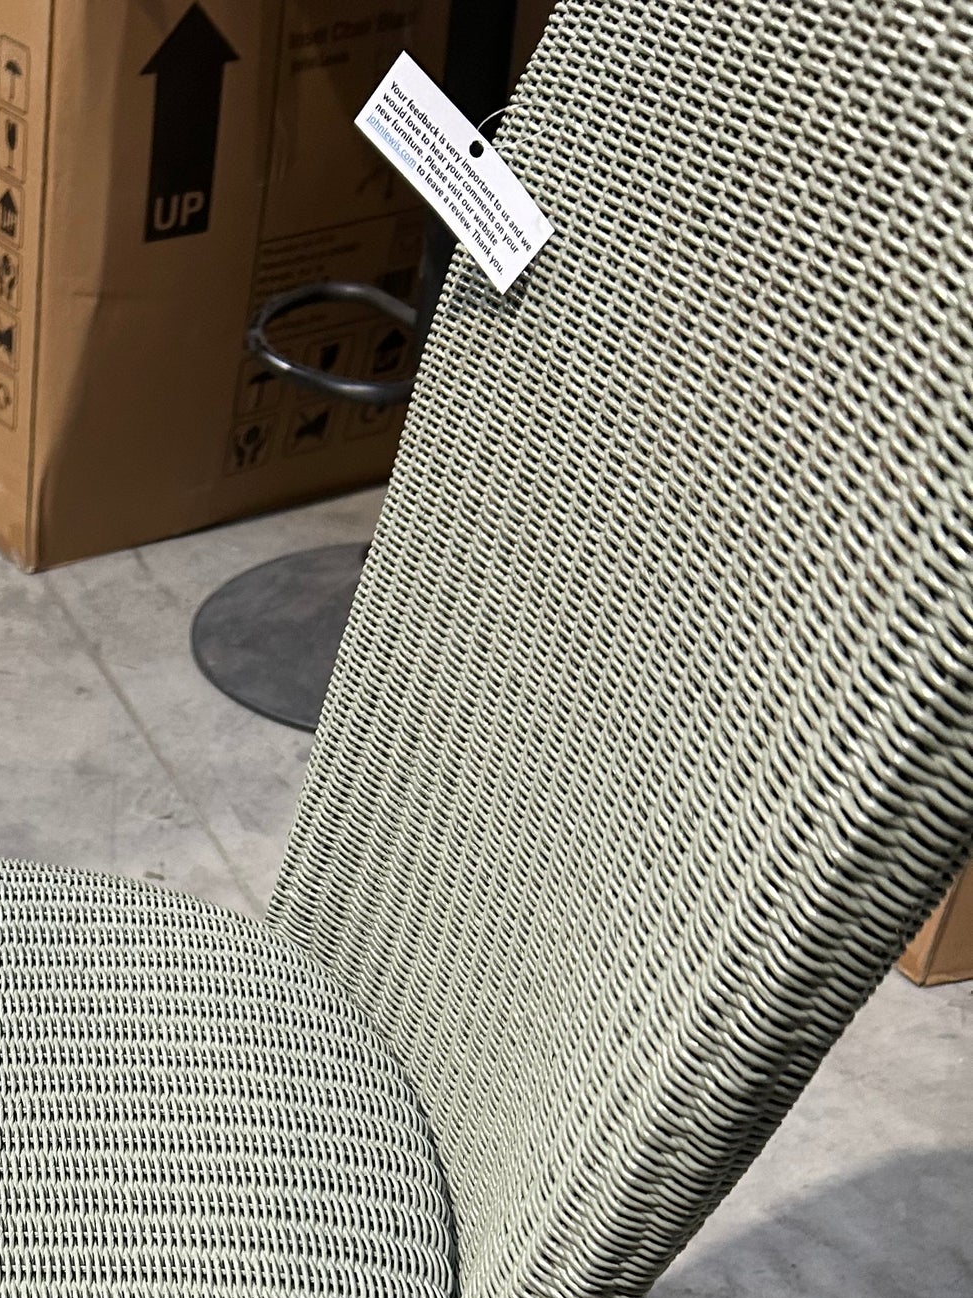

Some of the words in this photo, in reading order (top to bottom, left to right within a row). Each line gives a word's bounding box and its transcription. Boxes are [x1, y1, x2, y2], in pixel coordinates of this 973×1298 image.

[154, 191, 205, 231] UP
[366, 113, 417, 169] johnlewis.com
[416, 164, 425, 176] to
[425, 173, 444, 197] leave
[443, 196, 449, 204] a
[448, 202, 472, 231] review.
[472, 229, 491, 257] Thank
[489, 256, 504, 275] you.
[375, 104, 392, 122] new
[391, 119, 423, 158] furniture.
[424, 155, 448, 183] Please
[447, 181, 463, 200] visit
[461, 199, 474, 214] our
[473, 214, 497, 246] website
[383, 93, 407, 119] would
[405, 115, 421, 136] love
[421, 133, 430, 145] to
[429, 141, 447, 163] hear
[445, 162, 463, 181] your
[462, 181, 495, 223] comments
[495, 222, 504, 234] on
[502, 233, 519, 253] your
[391, 81, 408, 102] Your
[407, 99, 439, 137] feedback
[438, 134, 446, 145] is
[446, 142, 462, 163] very
[461, 158, 495, 201] important
[493, 199, 502, 211] to
[501, 210, 510, 222] us
[509, 221, 523, 238] and
[521, 237, 532, 252] we
